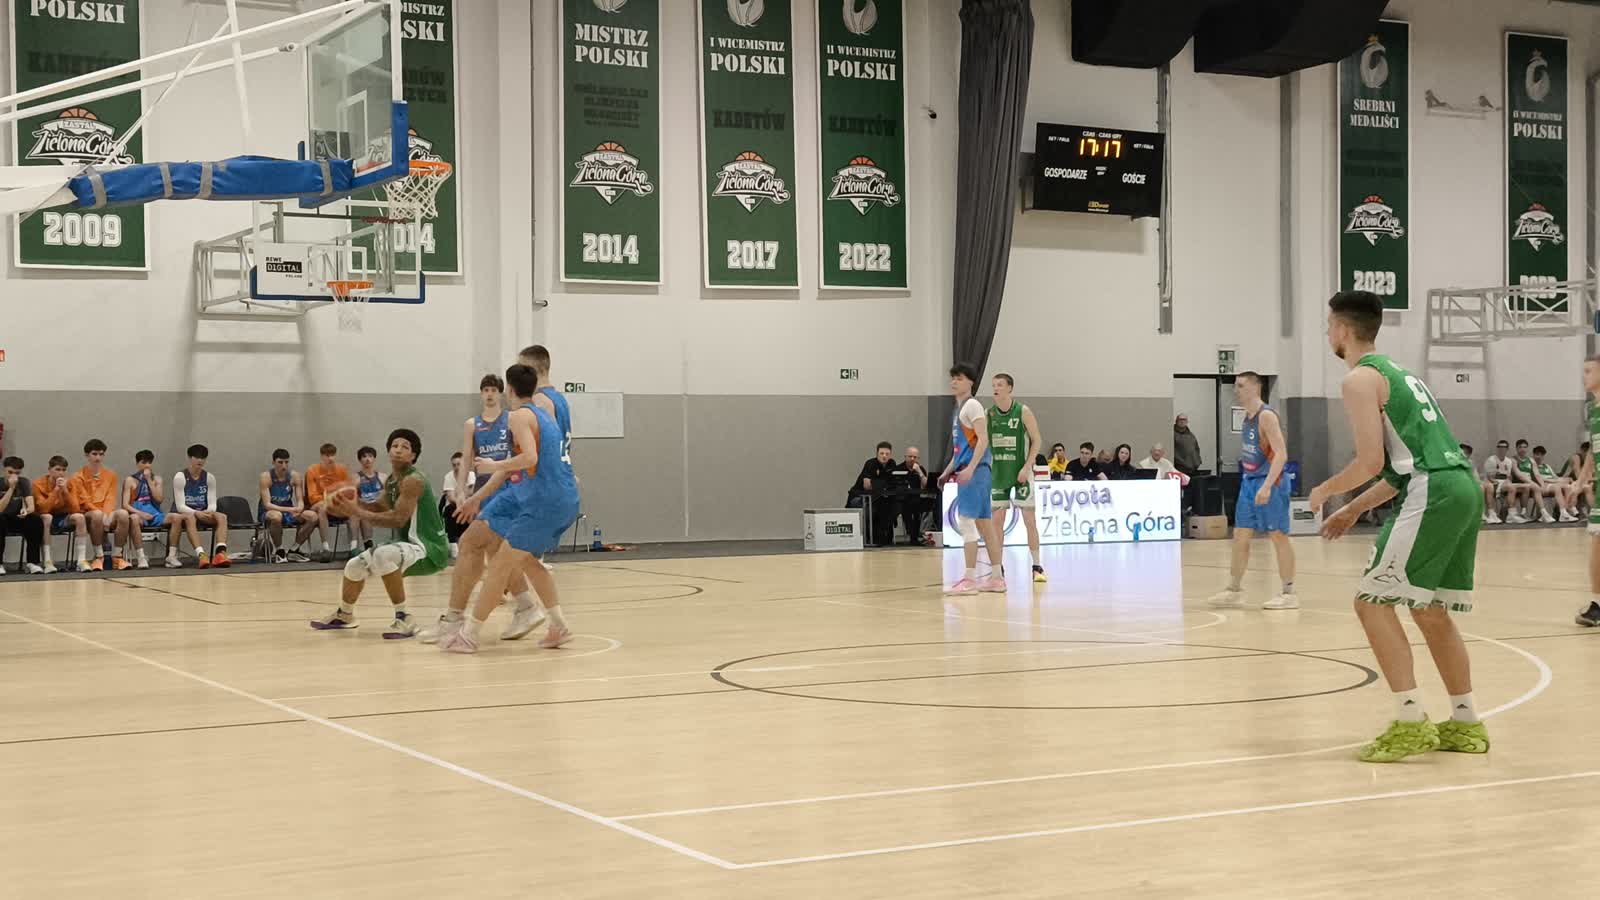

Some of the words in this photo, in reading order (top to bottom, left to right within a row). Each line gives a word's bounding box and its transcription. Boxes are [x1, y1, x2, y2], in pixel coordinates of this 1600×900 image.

[30, 0, 125, 23] POLSKI
[400, 20, 445, 41] SKI
[575, 23, 648, 46] MISTRZ
[710, 37, 715, 47] I
[718, 38, 785, 52] WICEMISTRZ
[827, 45, 834, 54] II
[837, 45, 896, 59] WICEMISTRZ
[575, 45, 648, 68] POLSKI
[710, 53, 785, 75] POLSKI
[827, 59, 896, 80] POLSKI
[1353, 98, 1395, 113] SREBRNI
[1350, 113, 1399, 129] MEDALIŚCI
[1513, 122, 1562, 140] POLSKI
[1044, 167, 1088, 180] GOSPODARZE
[1122, 172, 1146, 184] GOŚCIE
[43, 211, 122, 247] 2009
[386, 222, 435, 253] 014
[583, 232, 639, 264] 2014
[727, 240, 779, 269] 2017
[839, 242, 891, 271] 2022
[267, 263, 301, 272] DIGITAL
[1353, 270, 1396, 295] 2023
[1405, 375, 1444, 422] 9
[499, 429, 506, 440] 3
[1008, 418, 1020, 429] 47
[1038, 484, 1112, 512] Toyota
[1041, 513, 1118, 538] Zielona
[1126, 511, 1175, 532] Góra
